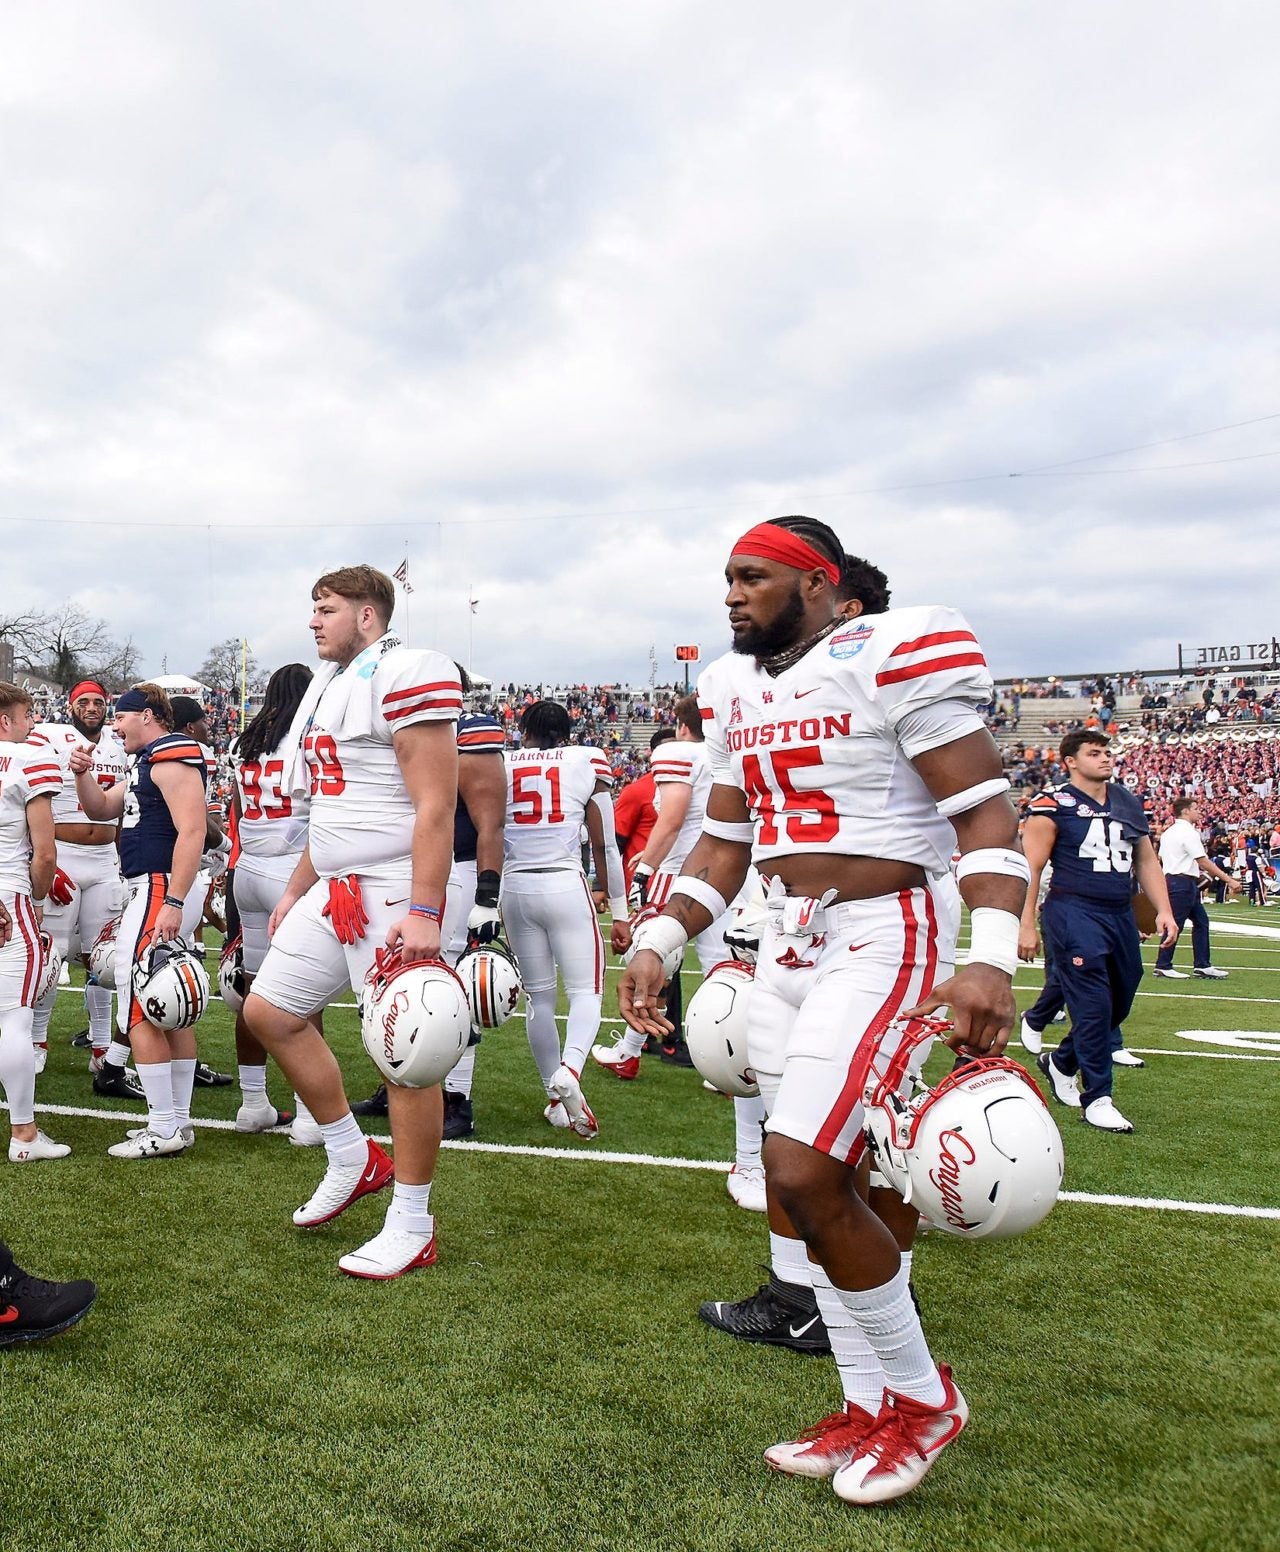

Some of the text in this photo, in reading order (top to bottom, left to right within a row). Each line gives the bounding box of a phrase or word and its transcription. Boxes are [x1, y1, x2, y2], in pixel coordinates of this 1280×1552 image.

[677, 646, 698, 660] 40
[510, 750, 564, 761] GARNER
[726, 713, 852, 753] HOUSTON
[239, 760, 292, 820] 93
[513, 766, 565, 825] 51
[742, 745, 840, 845] 45
[1078, 818, 1133, 873] 46
[382, 991, 410, 1061] Cougars
[968, 1075, 1008, 1091] HOUSTON
[17, 1151, 30, 1160] 47
[929, 1130, 976, 1229] Cougars
